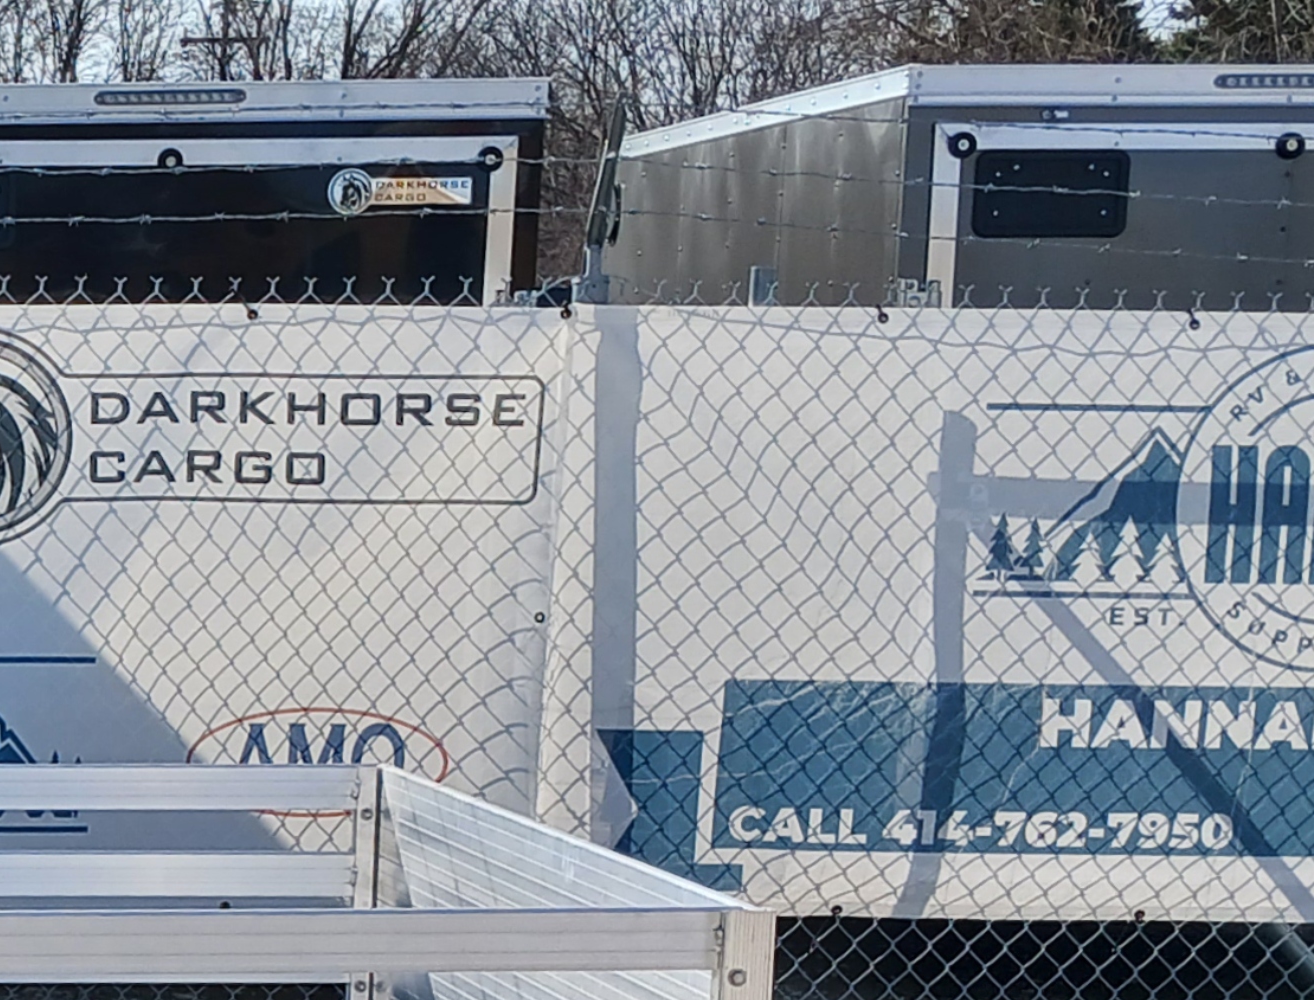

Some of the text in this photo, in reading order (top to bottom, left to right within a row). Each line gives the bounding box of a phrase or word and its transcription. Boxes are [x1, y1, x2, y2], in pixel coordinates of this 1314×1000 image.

[374, 193, 426, 202] CARGO
[375, 180, 469, 189] DARKHORSE
[90, 390, 526, 428] DARKHORSE
[1229, 386, 1265, 422] RV
[89, 450, 326, 486] CARGO
[1204, 445, 1314, 585] HA
[1109, 607, 1185, 627] EST.
[1039, 698, 1314, 750] HANNA
[728, 806, 1234, 849] CALL 414-762-7950
